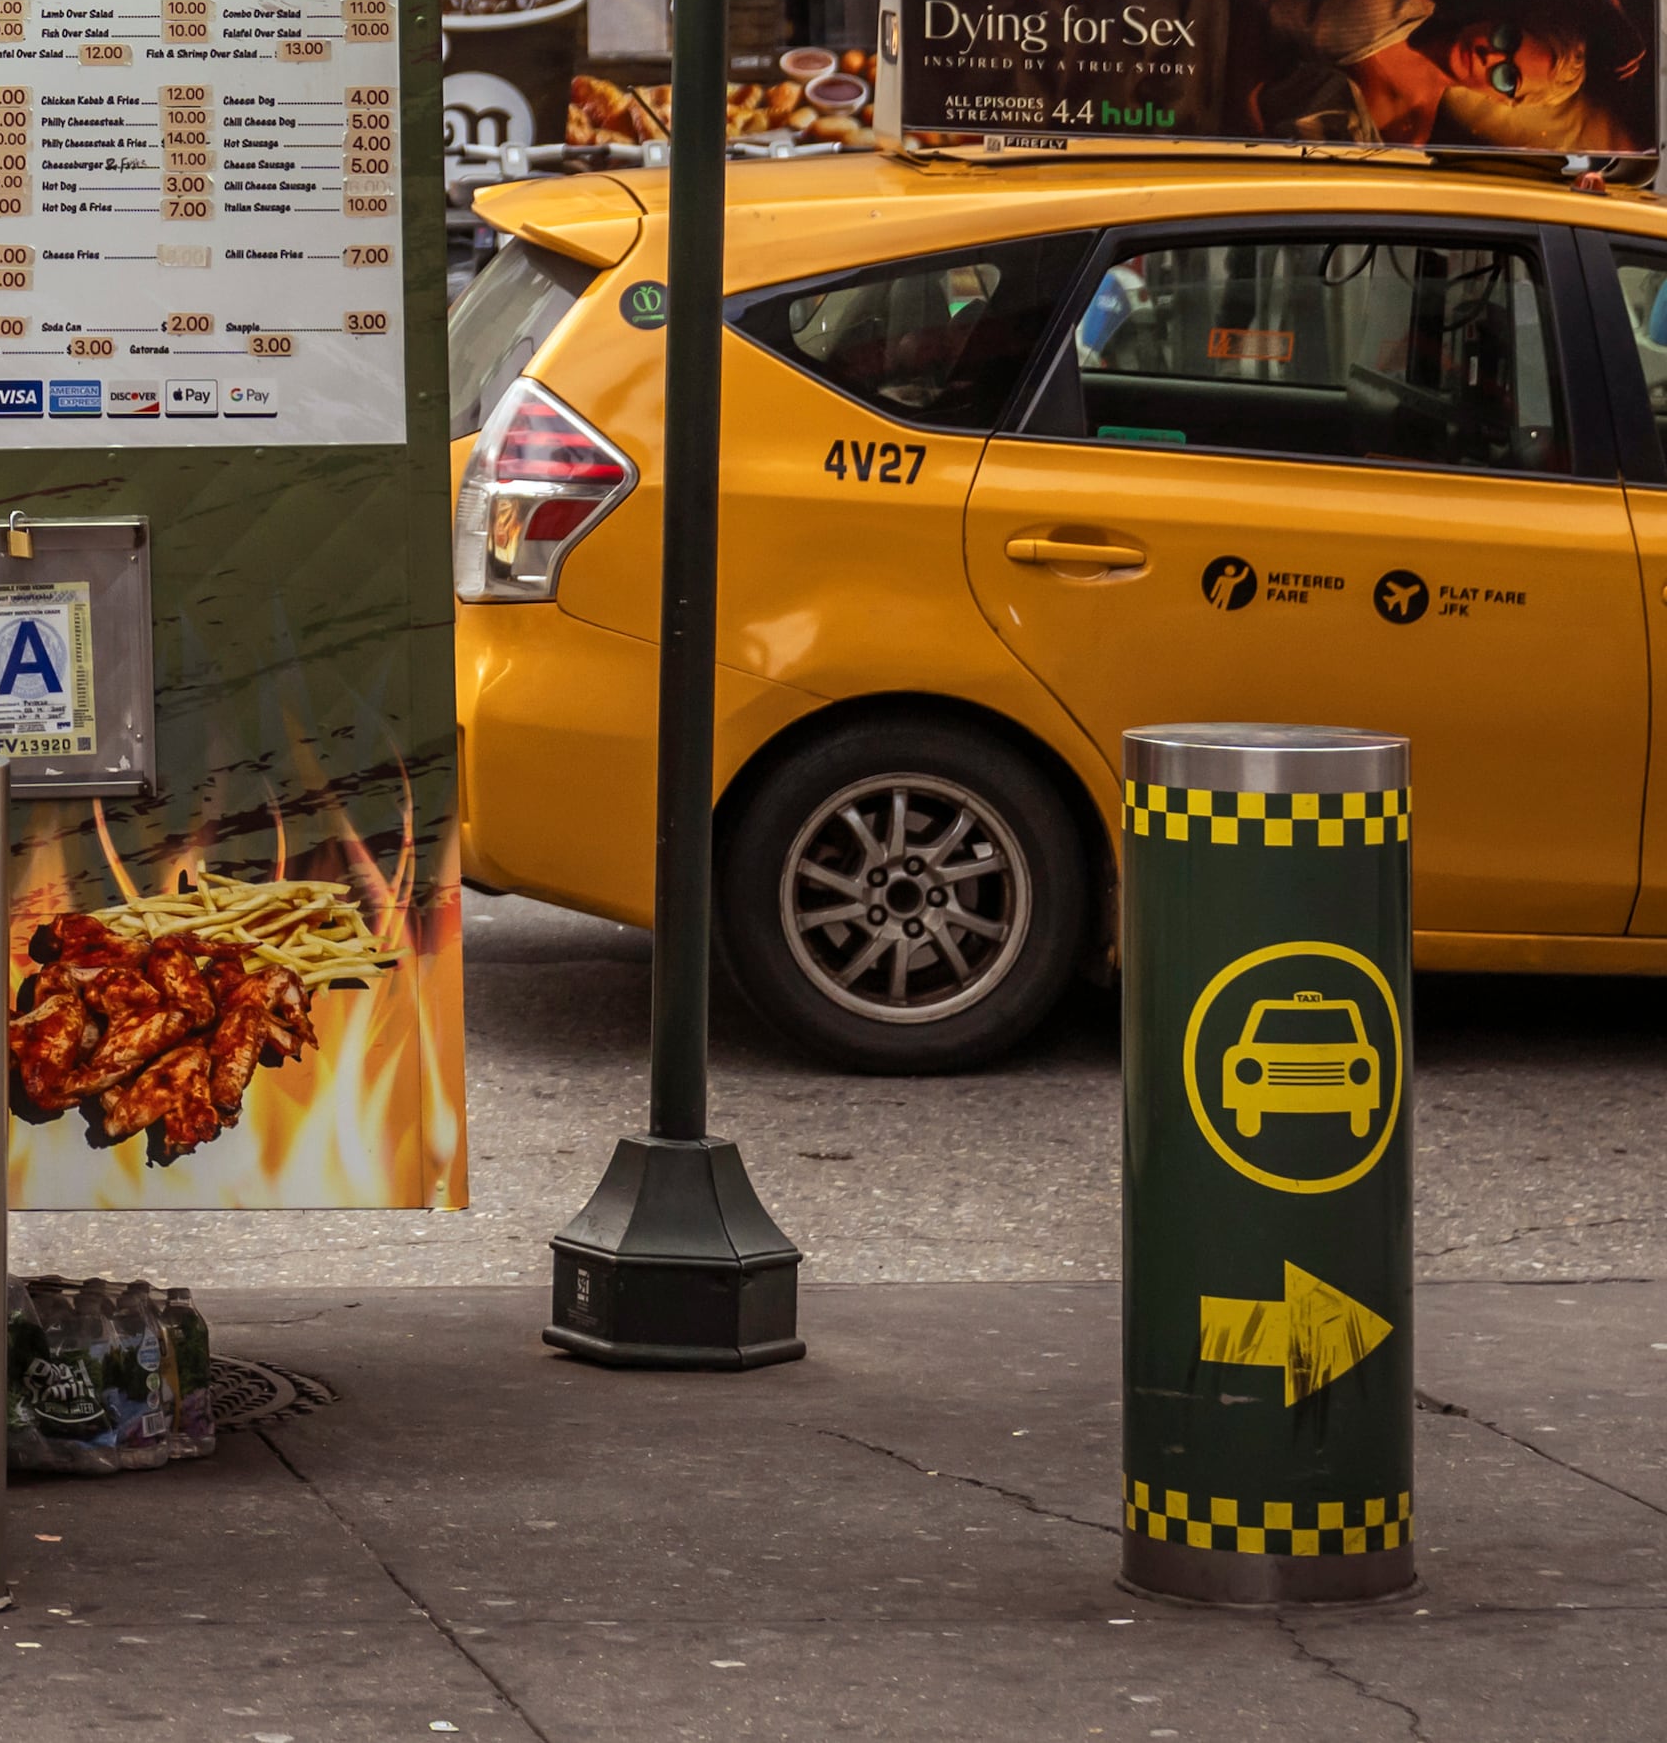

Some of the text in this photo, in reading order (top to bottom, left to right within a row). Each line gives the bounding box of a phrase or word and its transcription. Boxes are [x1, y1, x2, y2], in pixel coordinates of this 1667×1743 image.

[924, 0, 1196, 55] Dying for Sex
[924, 55, 1197, 76] INSPIRED BY A TRUE STORY
[945, 95, 1044, 109] ALL EPISODES
[945, 108, 1045, 123] STREAMING
[1051, 99, 1094, 125] 4.4
[1101, 100, 1176, 128] hulu
[1006, 137, 1066, 150] FIREFLY
[41, 177, 205, 193] Hot Dog 3.00
[224, 198, 388, 214] Italian Sausage 10.00
[73, 340, 113, 356] 3.00
[50, 386, 99, 397] AMERICAN
[110, 391, 157, 402] DISCOVER
[185, 388, 211, 405] Pay
[246, 388, 270, 405] Pay
[59, 397, 100, 407] EXPRESS
[823, 439, 927, 485] 4V27
[1268, 571, 1346, 591] METERED
[1267, 588, 1309, 605] FARE
[1439, 585, 1527, 606] FLAT FARE
[1438, 603, 1471, 618] JFK
[1296, 994, 1321, 1003] TAXI
